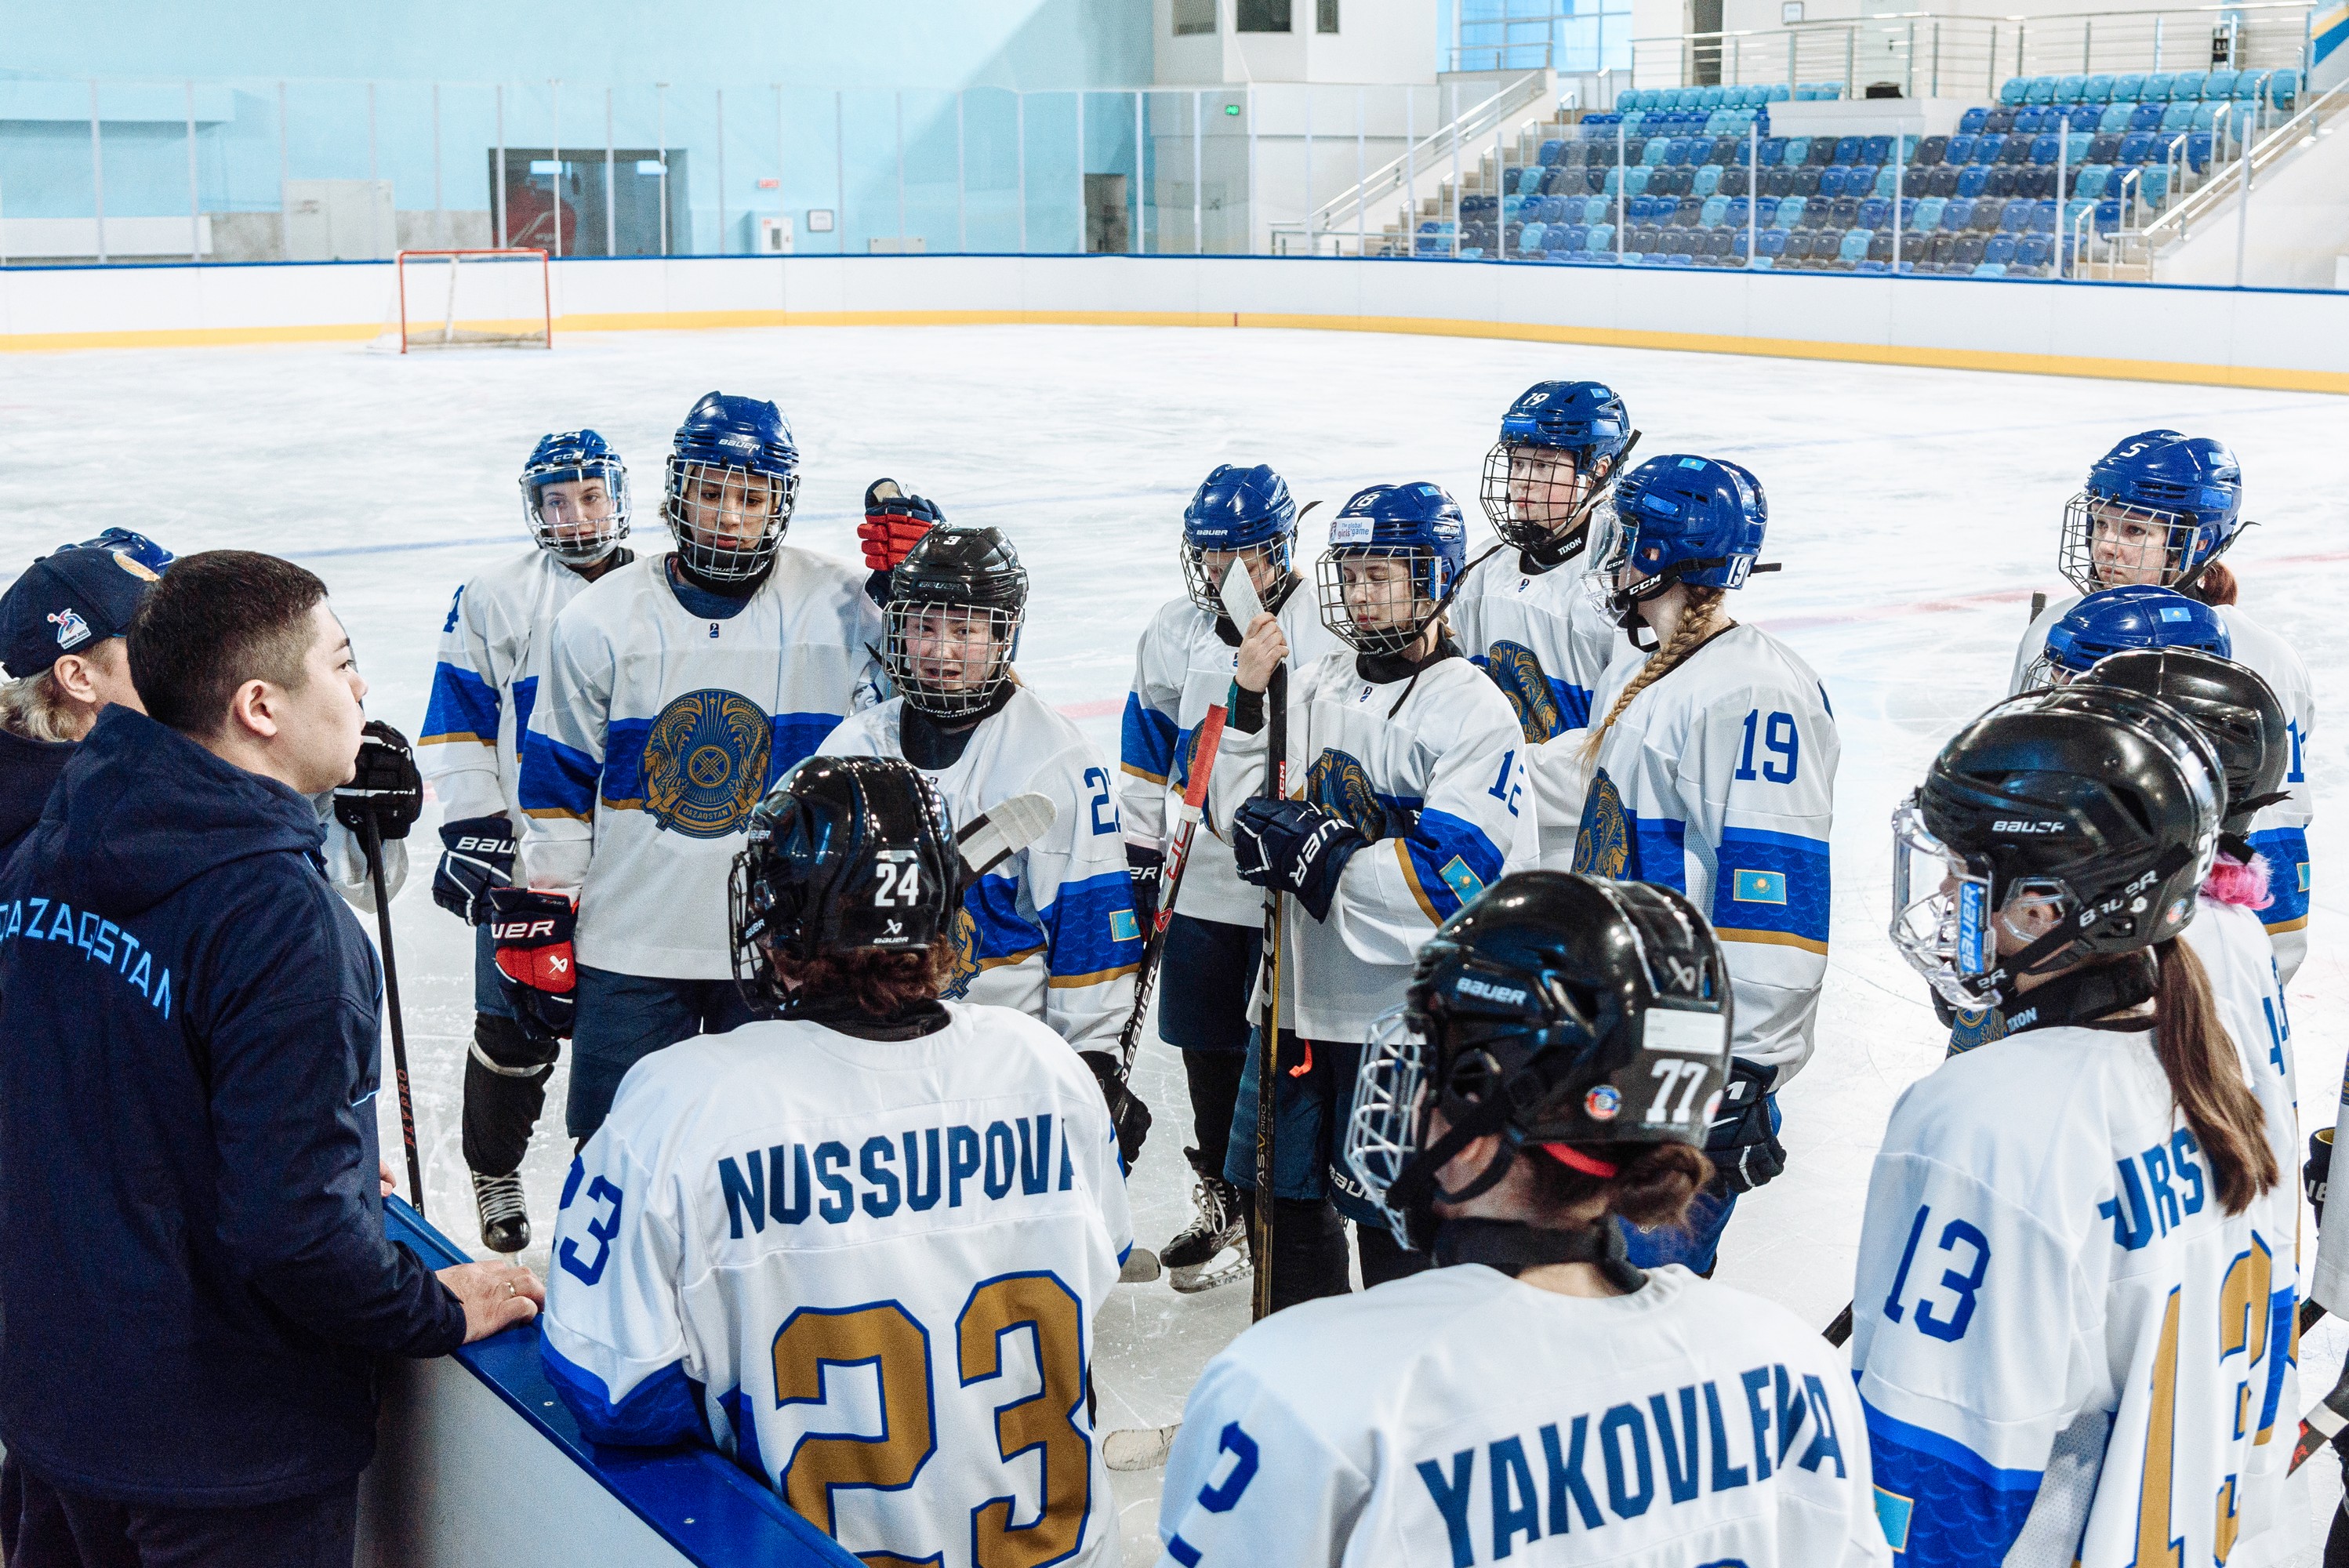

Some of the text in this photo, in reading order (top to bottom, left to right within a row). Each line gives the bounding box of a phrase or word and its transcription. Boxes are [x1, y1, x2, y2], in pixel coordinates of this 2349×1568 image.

[1523, 392, 1550, 406] 19
[718, 438, 761, 451] BAUER
[2118, 442, 2150, 457] 5
[1349, 494, 1380, 508] 18
[1352, 528, 1370, 537] game
[1432, 525, 1460, 535] BAUER
[1557, 536, 1582, 556] TIXON
[1607, 558, 1625, 570] CCM
[1726, 556, 1751, 586] 19
[1628, 573, 1661, 596] CCM
[1734, 709, 1799, 784] 19
[683, 808, 728, 820] QAZAQSTAN
[456, 837, 517, 855] BAU
[2194, 832, 2218, 885] 2
[874, 862, 919, 906] 24
[1961, 884, 1977, 971] BAUER
[1457, 977, 1527, 1007] BAUER
[1125, 966, 1157, 1066] BAUER
[1646, 1058, 1709, 1123] 77
[2097, 1127, 2223, 1252] URS
[1882, 1204, 1991, 1343] 13
[771, 1269, 1092, 1568] 23
[1416, 1363, 1847, 1568] YAKOVLEVA
